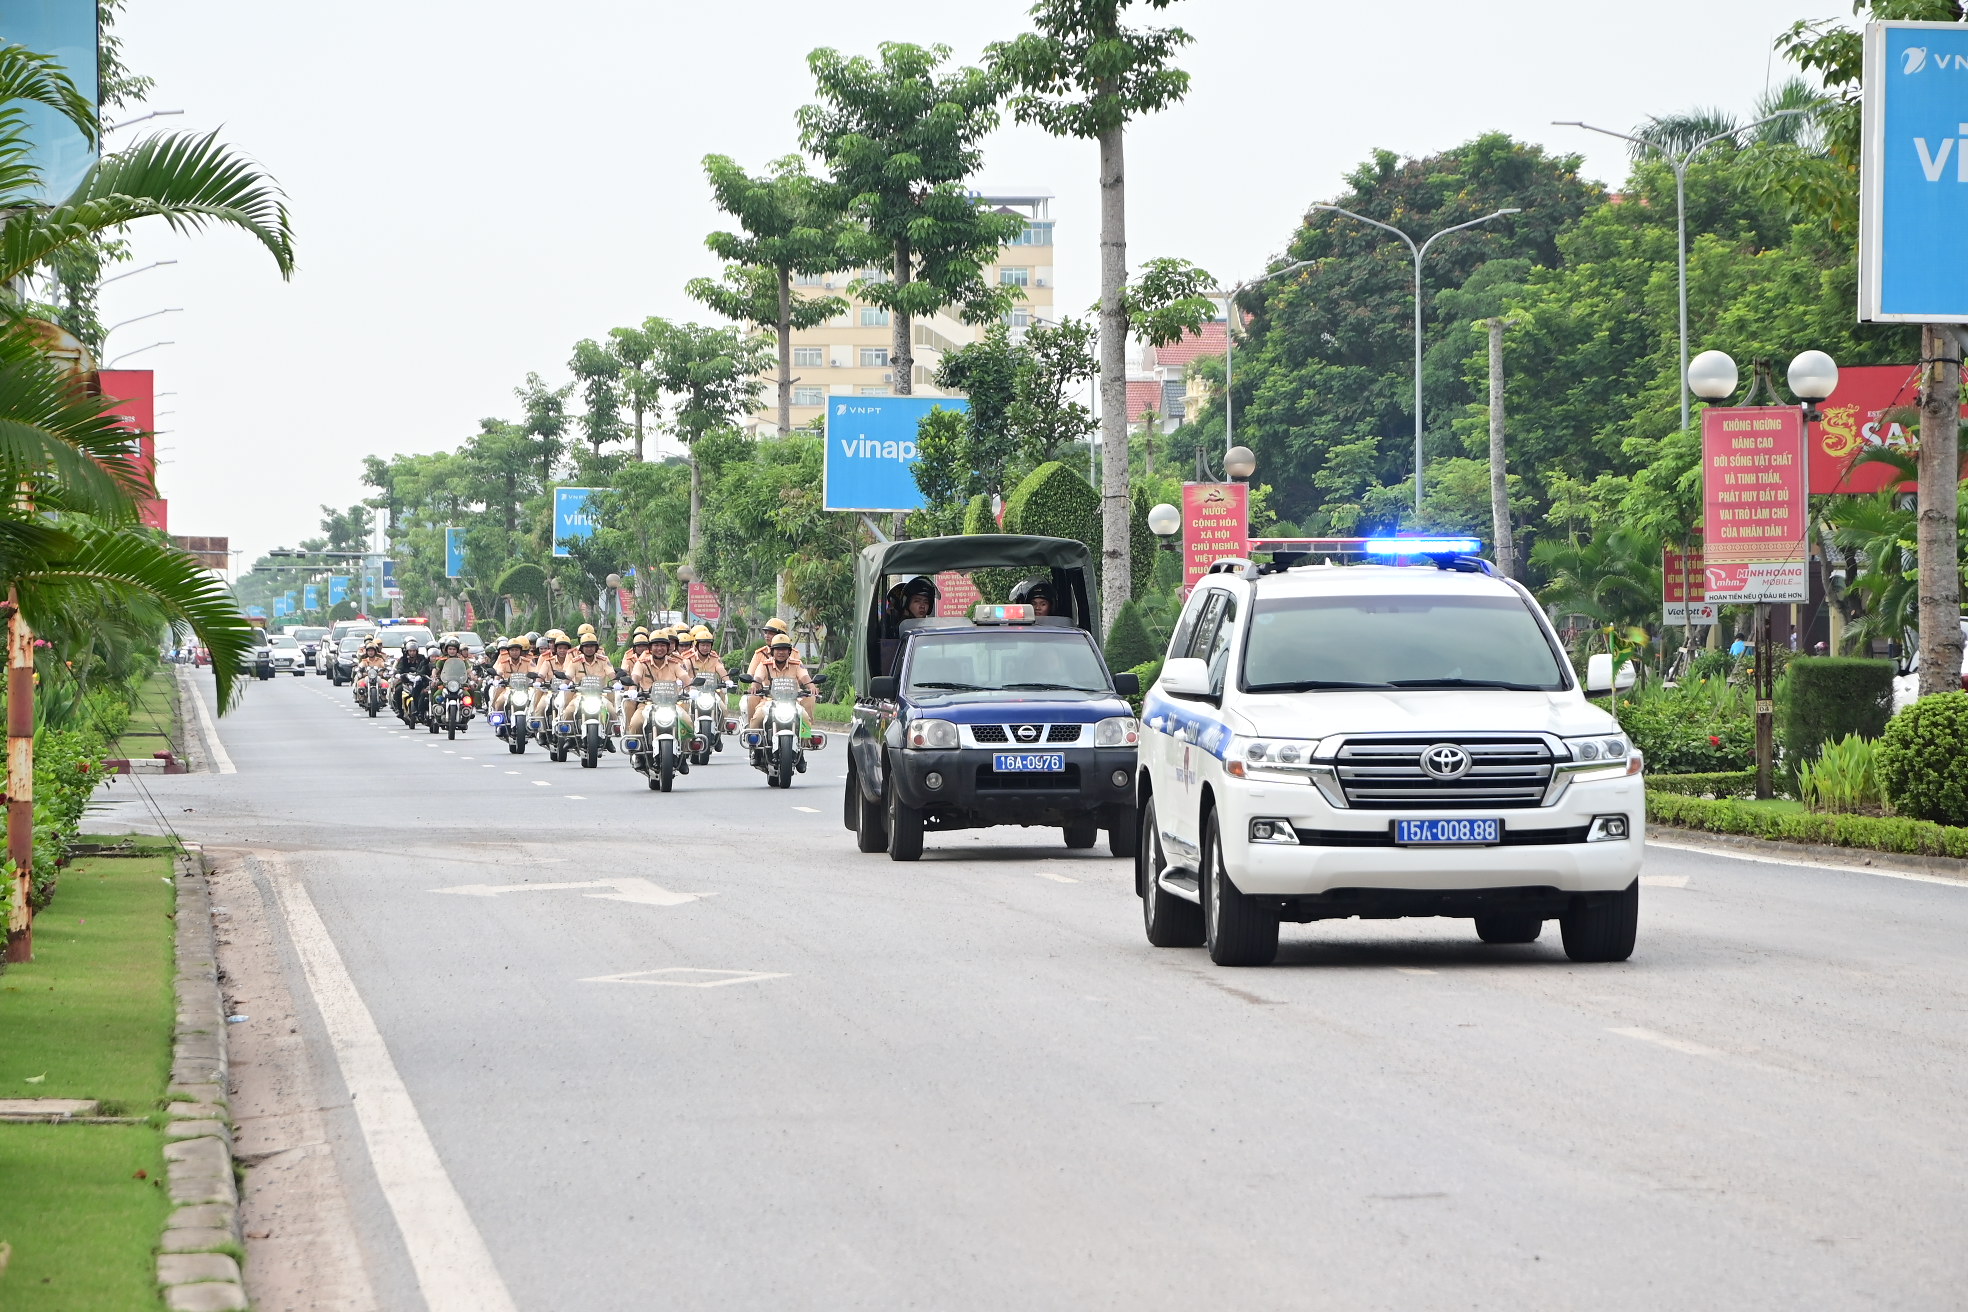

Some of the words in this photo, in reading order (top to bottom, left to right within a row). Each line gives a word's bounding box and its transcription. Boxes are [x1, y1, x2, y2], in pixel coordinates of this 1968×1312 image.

[1913, 122, 1968, 183] vi
[1723, 418, 1751, 431] KHÔNG
[1753, 417, 1782, 431] NGỪNG
[1732, 436, 1755, 449] NÂNG
[1757, 437, 1774, 448] CAO
[1861, 421, 1919, 451] SA
[841, 434, 923, 463] vinap
[1714, 454, 1728, 467] ĐỜI
[1729, 452, 1752, 467] SỐNG
[1754, 453, 1769, 468] VẬT
[1771, 451, 1793, 466] CHẤT
[1725, 472, 1736, 485] VÀ
[1737, 473, 1756, 484] TINH
[1719, 489, 1740, 503] PHÁT
[1741, 491, 1758, 502] HUY
[1777, 487, 1789, 501] ĐỦ
[1202, 507, 1227, 515] NƯỚC
[1720, 509, 1733, 520] VAI
[1735, 506, 1750, 520] TRÒ
[1752, 506, 1770, 519] LÀM
[1771, 504, 1789, 519] CHỦ
[1192, 519, 1217, 529] CỘNG
[1219, 517, 1238, 527] HÒA
[1200, 531, 1213, 539] XÃ
[1215, 531, 1230, 540] HỘI
[1721, 523, 1738, 538] CỦA
[1740, 524, 1763, 538] NHÂN
[1765, 523, 1782, 537] DÂN
[1191, 541, 1210, 551] CHỦ
[1212, 541, 1240, 550] NGHĨA
[1194, 554, 1213, 564] VIỆT
[1737, 568, 1764, 578] MINH
[1762, 578, 1793, 586] MOBILE
[1743, 592, 1757, 600] NẾU
[1667, 608, 1700, 616] Vietott
[1000, 755, 1059, 769] 16A-0976
[1401, 820, 1496, 841] 15A-008.88
